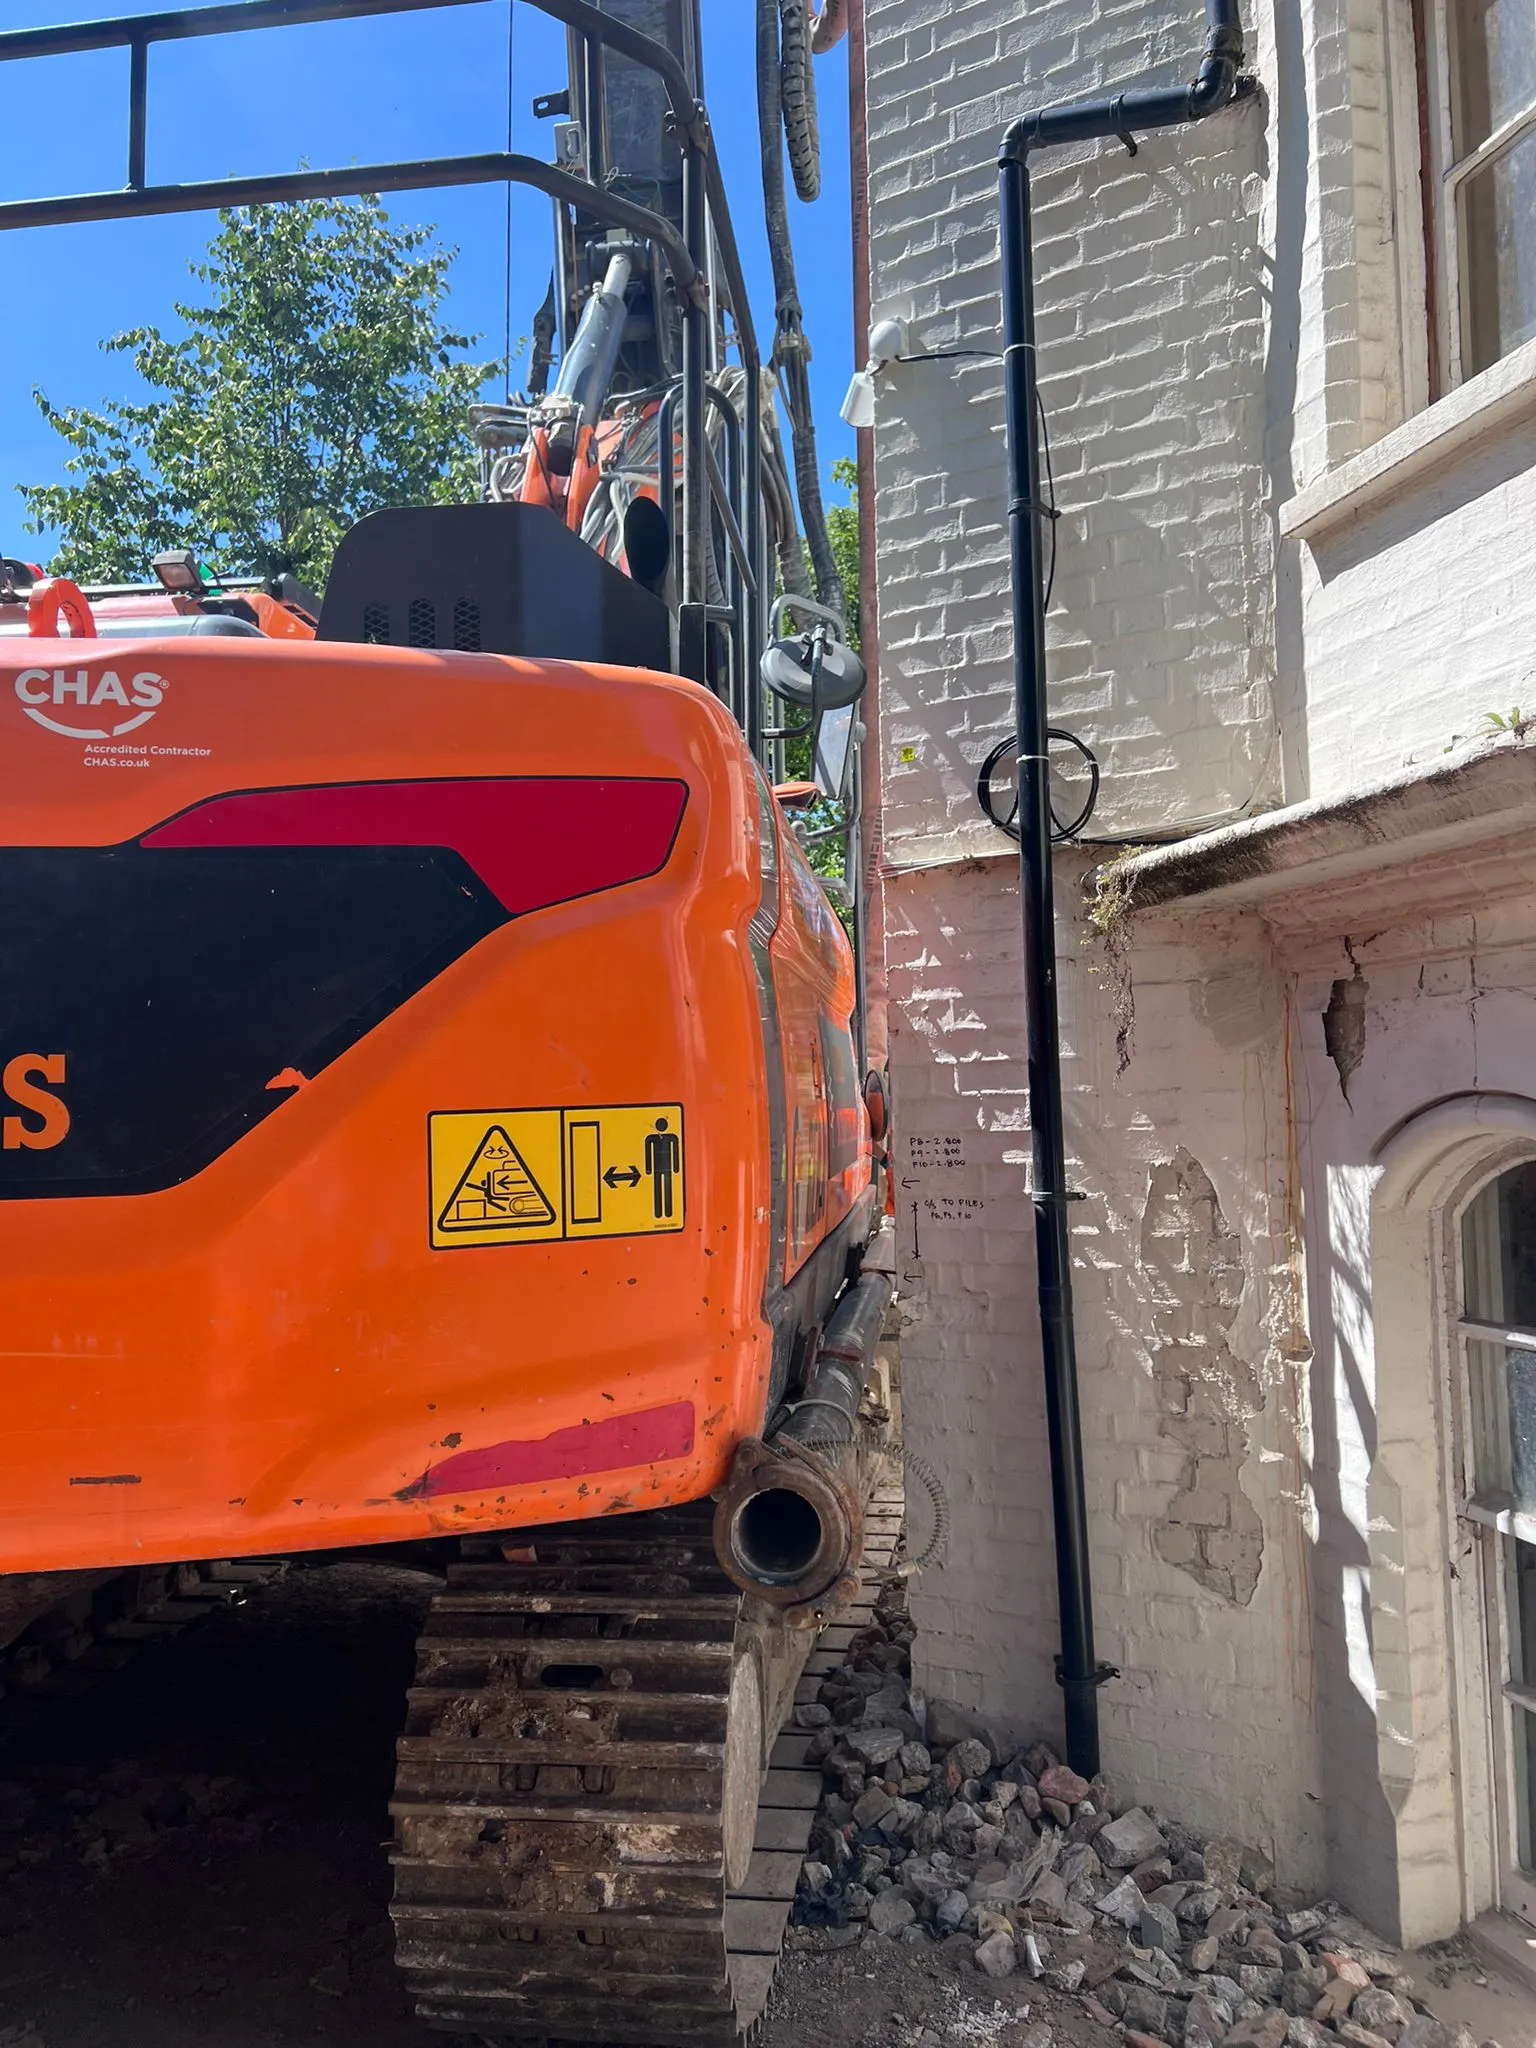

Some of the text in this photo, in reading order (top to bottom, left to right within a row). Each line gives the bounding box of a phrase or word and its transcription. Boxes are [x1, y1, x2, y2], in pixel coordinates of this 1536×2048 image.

[84, 744, 211, 757] Accredited Contractor
[83, 757, 150, 768] CHAS.co.uk
[941, 1198, 955, 1206] TO
[958, 1198, 984, 1209] PILES
